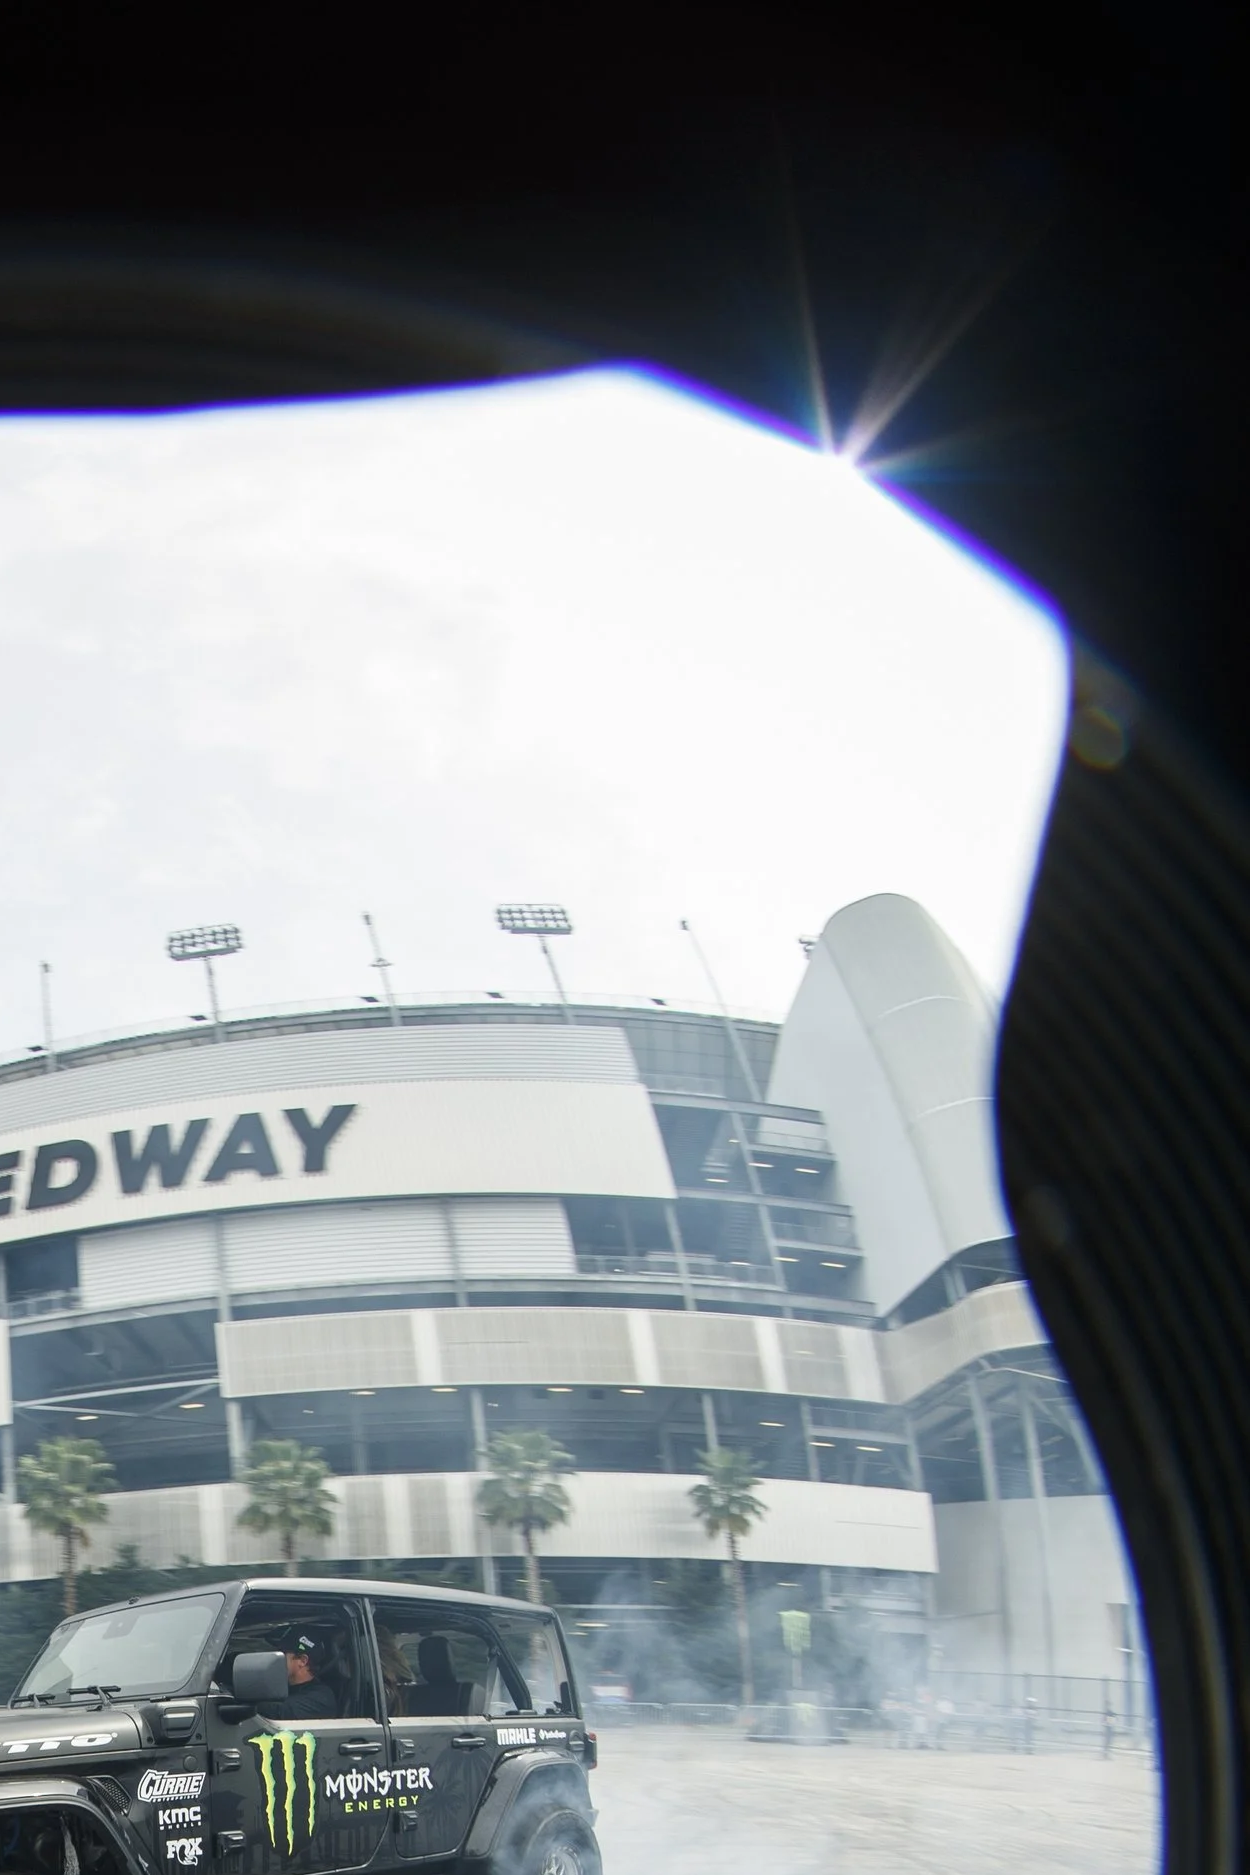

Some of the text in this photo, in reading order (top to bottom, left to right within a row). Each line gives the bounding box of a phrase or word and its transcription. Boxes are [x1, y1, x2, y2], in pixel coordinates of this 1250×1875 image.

[497, 1728, 537, 1745] MAHLE
[139, 1771, 204, 1800] CURRIE
[325, 1766, 434, 1800] MONSTER
[158, 1806, 202, 1825] KMC
[345, 1795, 419, 1813] ENERGY
[166, 1837, 203, 1866] FOX
